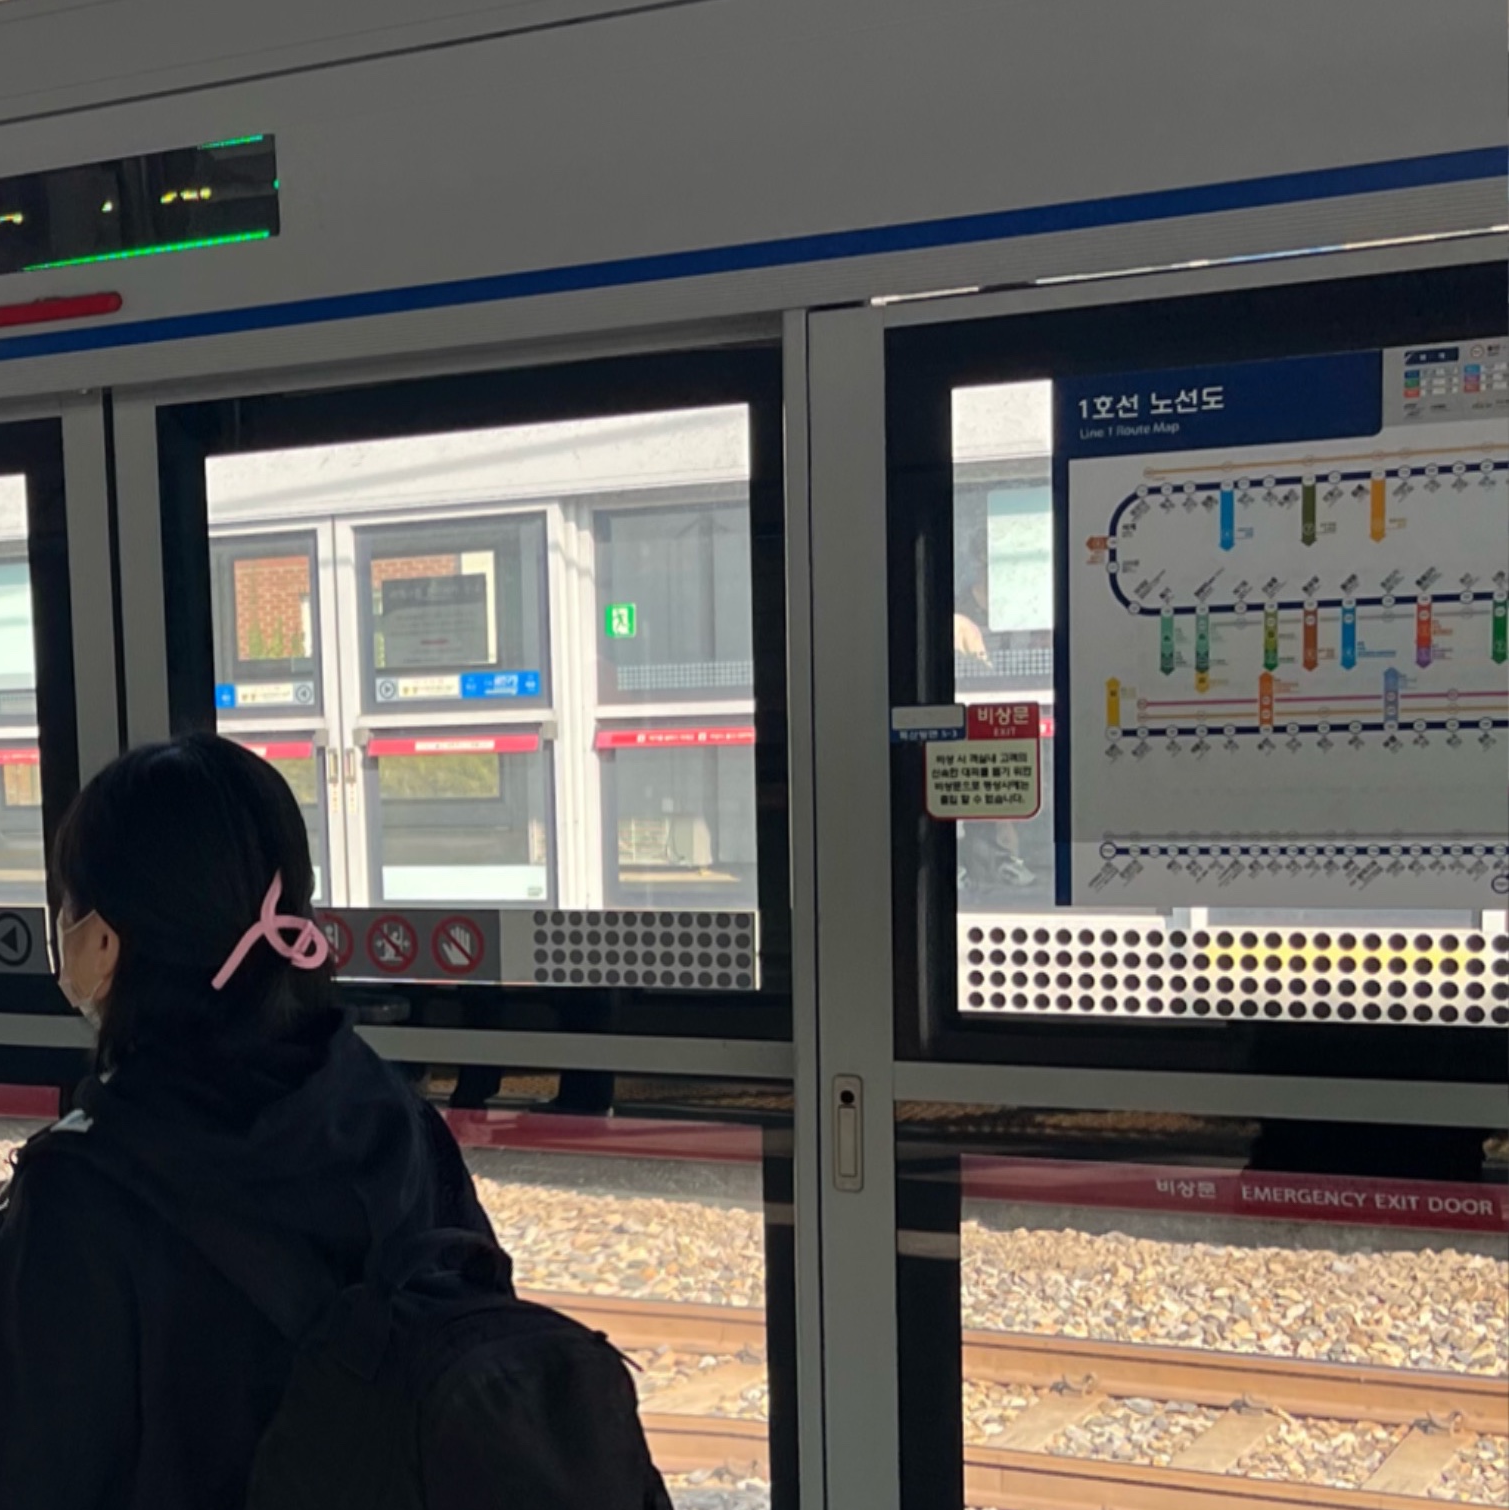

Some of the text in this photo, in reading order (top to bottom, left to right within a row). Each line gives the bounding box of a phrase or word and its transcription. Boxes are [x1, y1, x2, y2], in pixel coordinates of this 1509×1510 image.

[1078, 386, 1225, 420] 1호선 노선도
[1079, 426, 1104, 440] Line
[1116, 424, 1151, 436] Route
[1153, 422, 1180, 435] Map
[977, 705, 1029, 725] 비상문
[993, 726, 1017, 737] EXIT
[1156, 1179, 1494, 1216] 비상문 EMERGENCY EXIT DOOR
